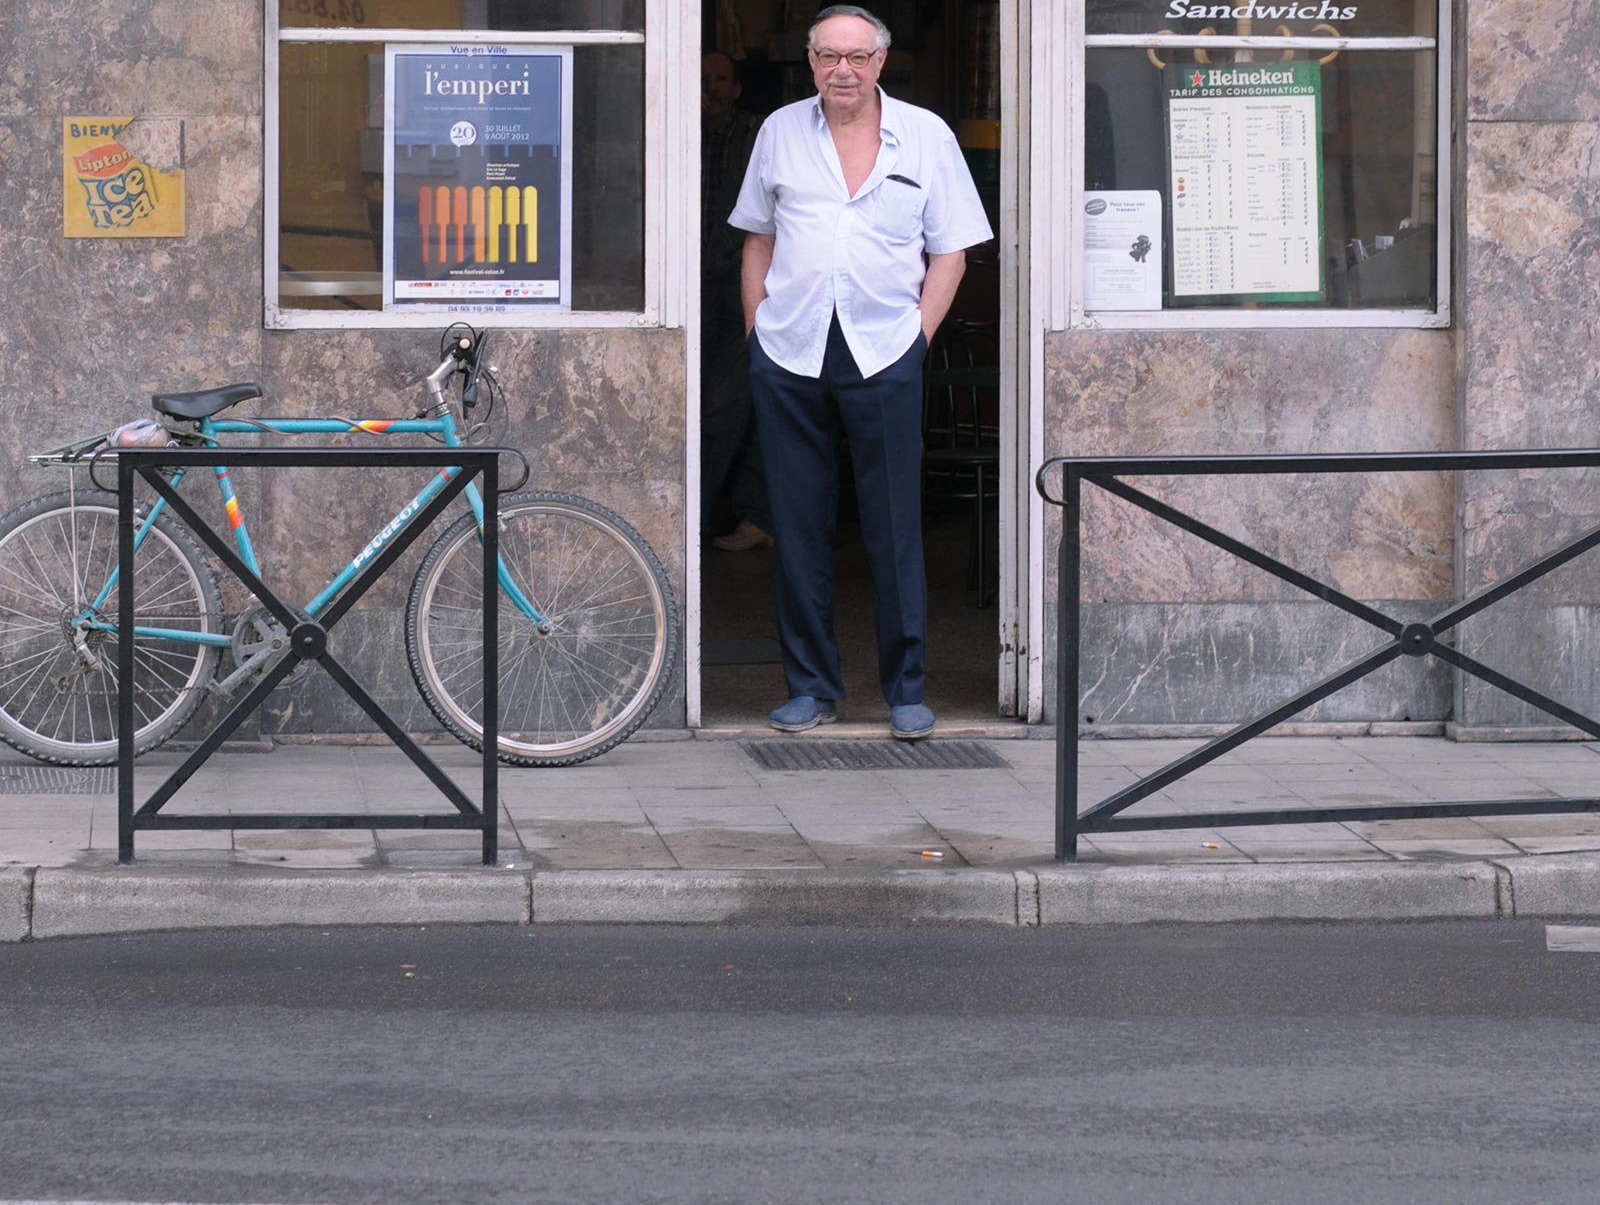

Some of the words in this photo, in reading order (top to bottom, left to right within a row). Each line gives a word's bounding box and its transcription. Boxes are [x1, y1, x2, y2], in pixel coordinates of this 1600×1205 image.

[451, 45, 469, 54] Vue
[487, 45, 508, 54] Ville
[424, 70, 531, 104] l'emperi
[1208, 69, 1294, 86] Heineken
[1170, 89, 1198, 97] TARIF
[1202, 88, 1222, 96] DES
[1226, 86, 1314, 96] CONSOMMATIONS
[452, 126, 475, 139] 20
[79, 151, 133, 172] Lipton
[79, 167, 145, 205] Ice
[87, 191, 154, 228] Tea
[352, 496, 420, 569] PEUGEOT
